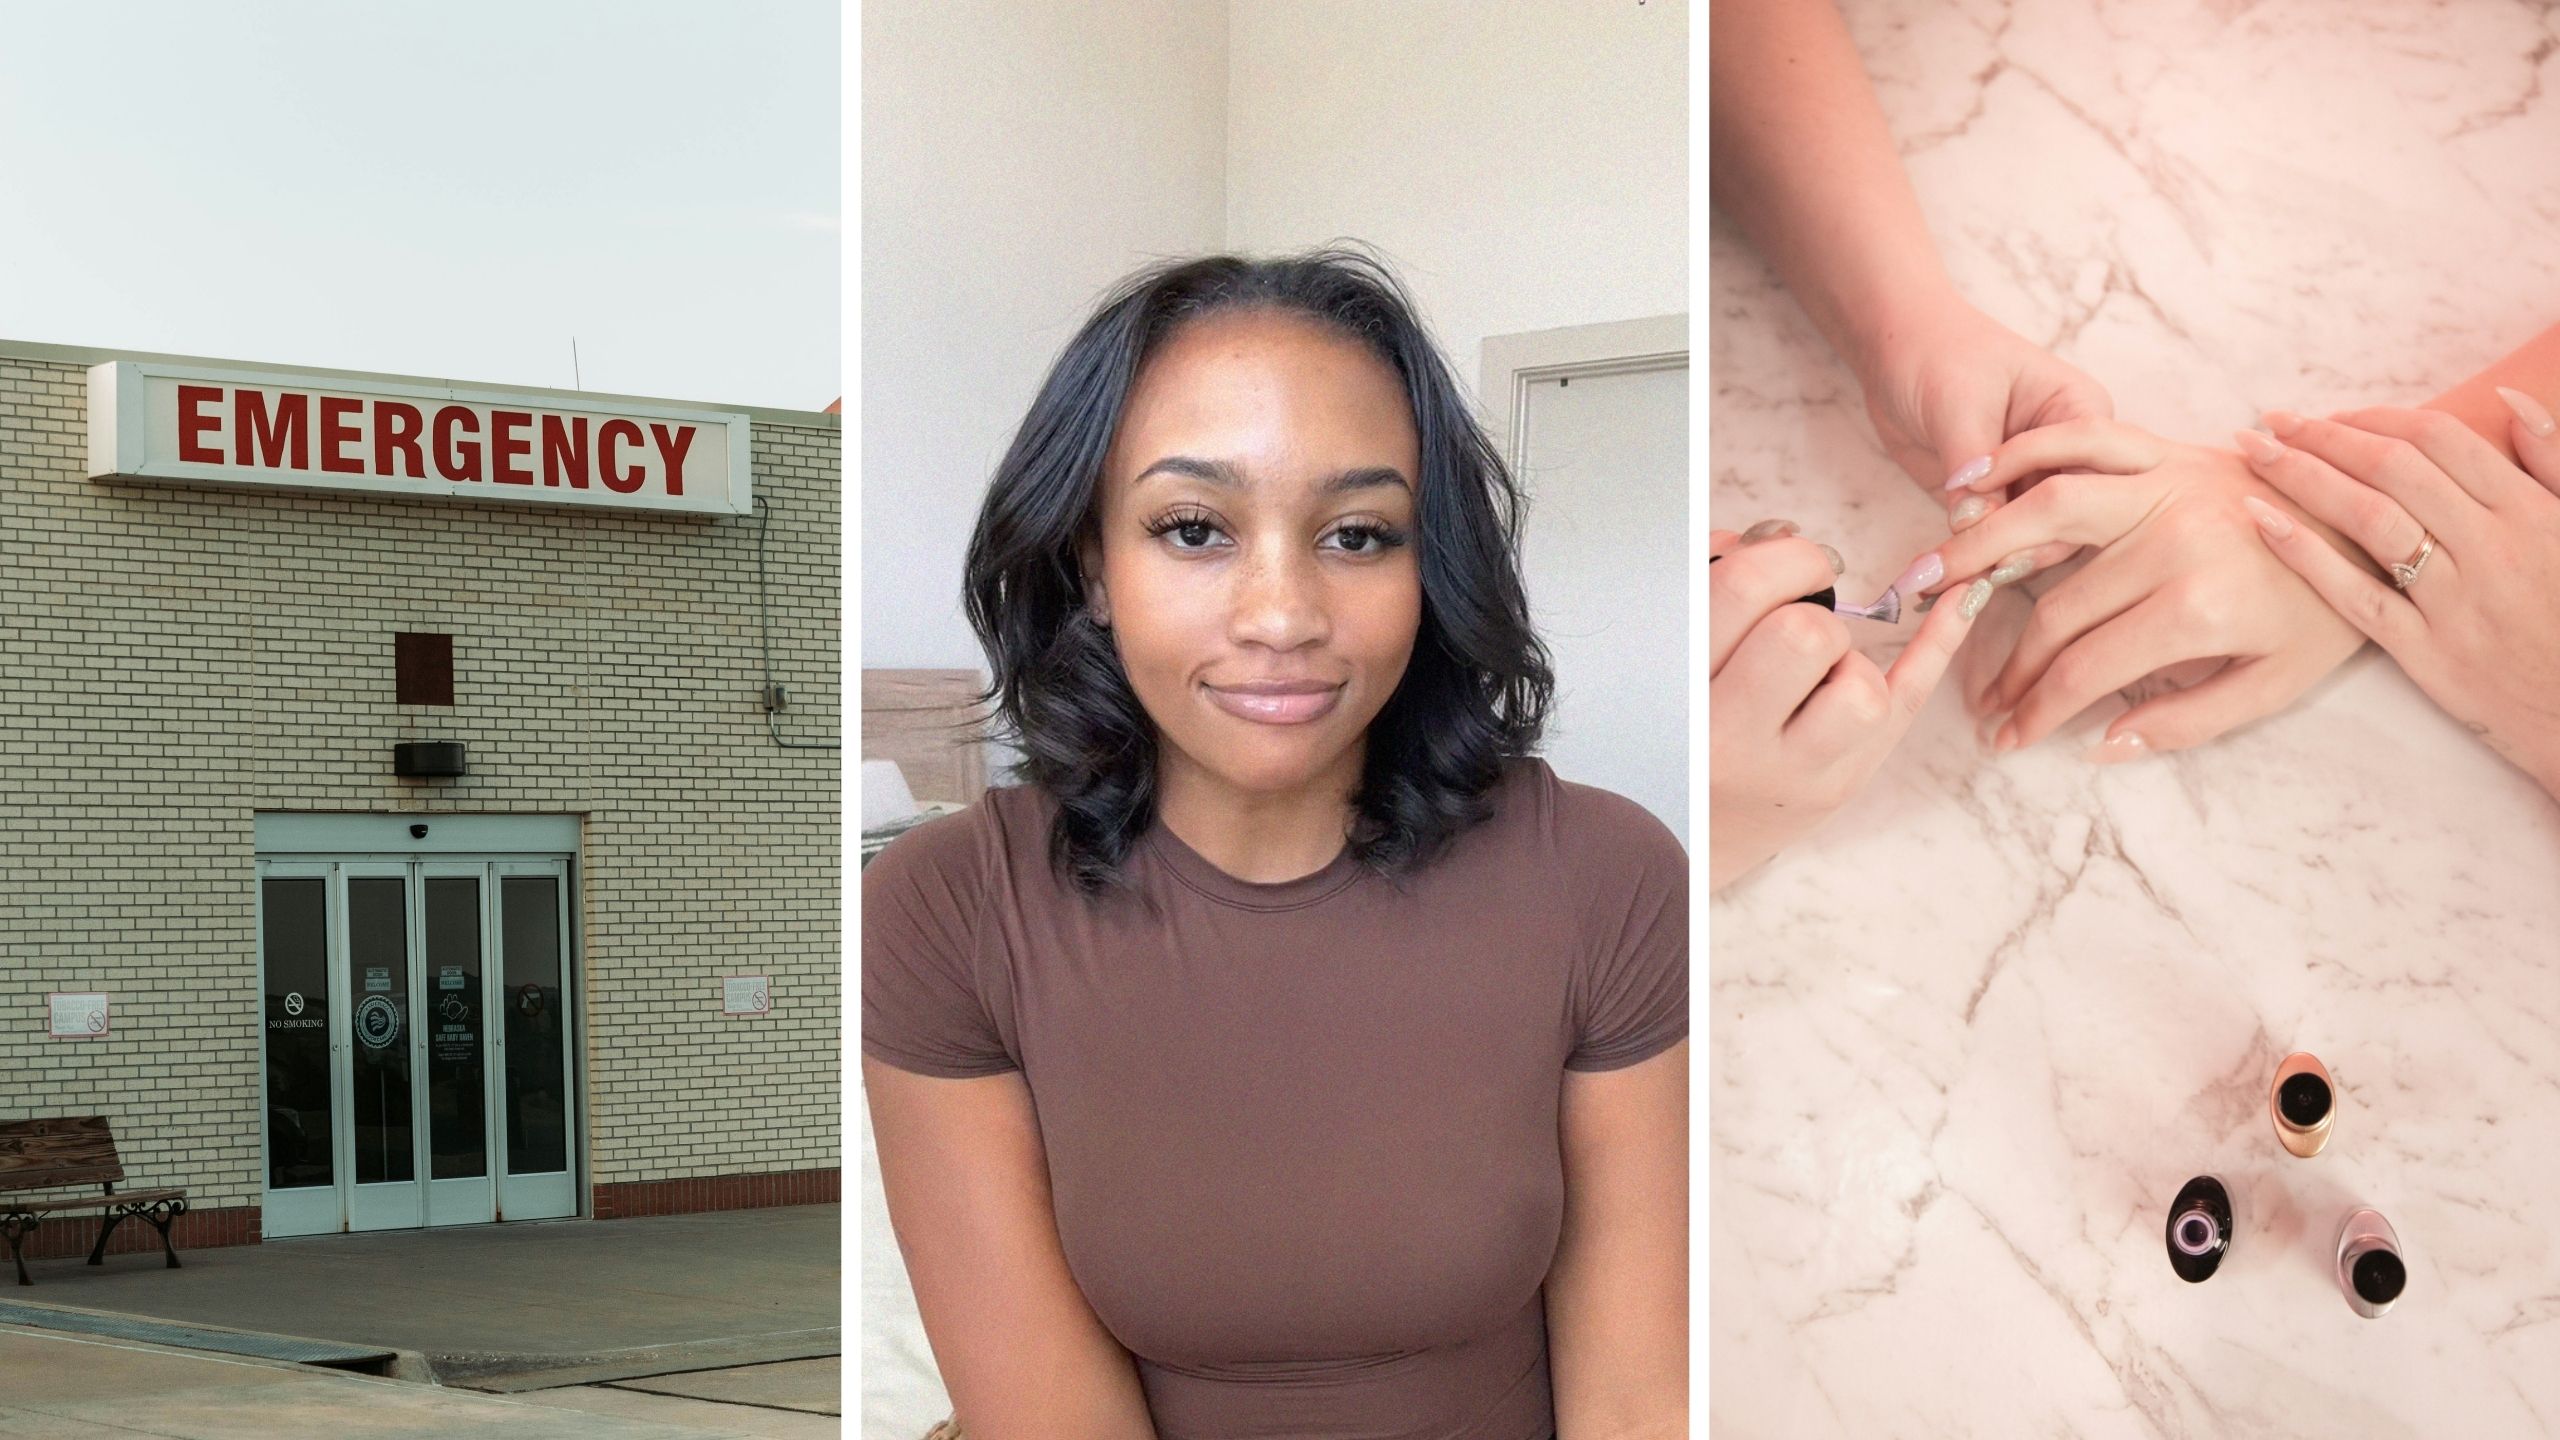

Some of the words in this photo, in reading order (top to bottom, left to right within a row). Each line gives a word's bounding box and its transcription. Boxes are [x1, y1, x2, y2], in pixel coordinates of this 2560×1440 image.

[178, 385, 697, 496] EMERGENCY
[269, 1020, 282, 1029] NO
[283, 1019, 323, 1028] SMOKING
